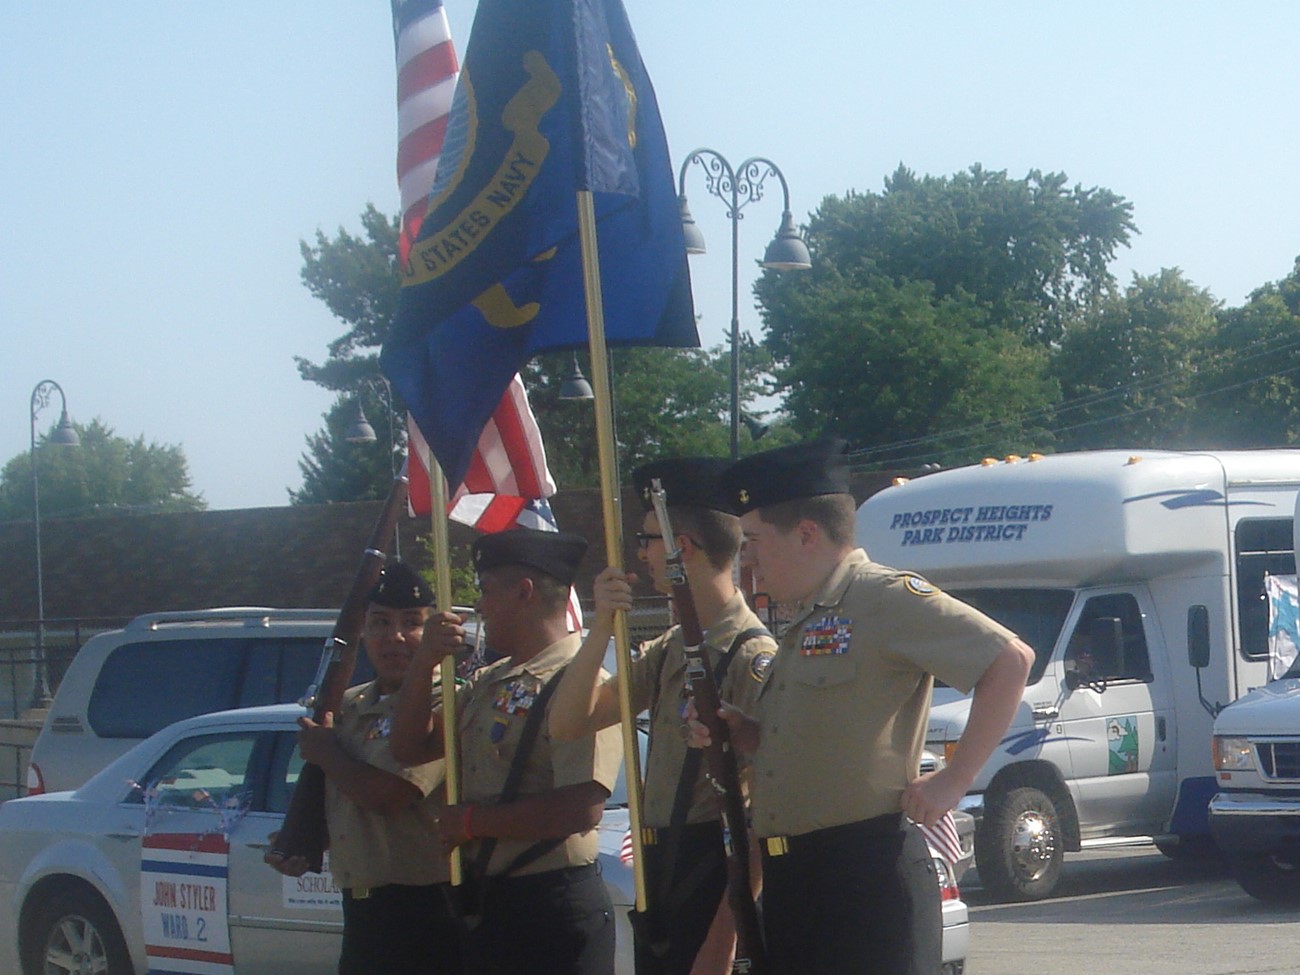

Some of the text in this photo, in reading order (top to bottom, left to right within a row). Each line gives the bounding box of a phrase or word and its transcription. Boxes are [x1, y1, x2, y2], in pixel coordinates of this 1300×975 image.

[421, 153, 535, 272] STATES NAVY
[890, 504, 1053, 530] PROSPECT HEIGHTS
[901, 523, 1028, 546] PARK DISTRICT
[153, 881, 216, 912] JOHN STYLER
[161, 912, 208, 942] WARD 2
